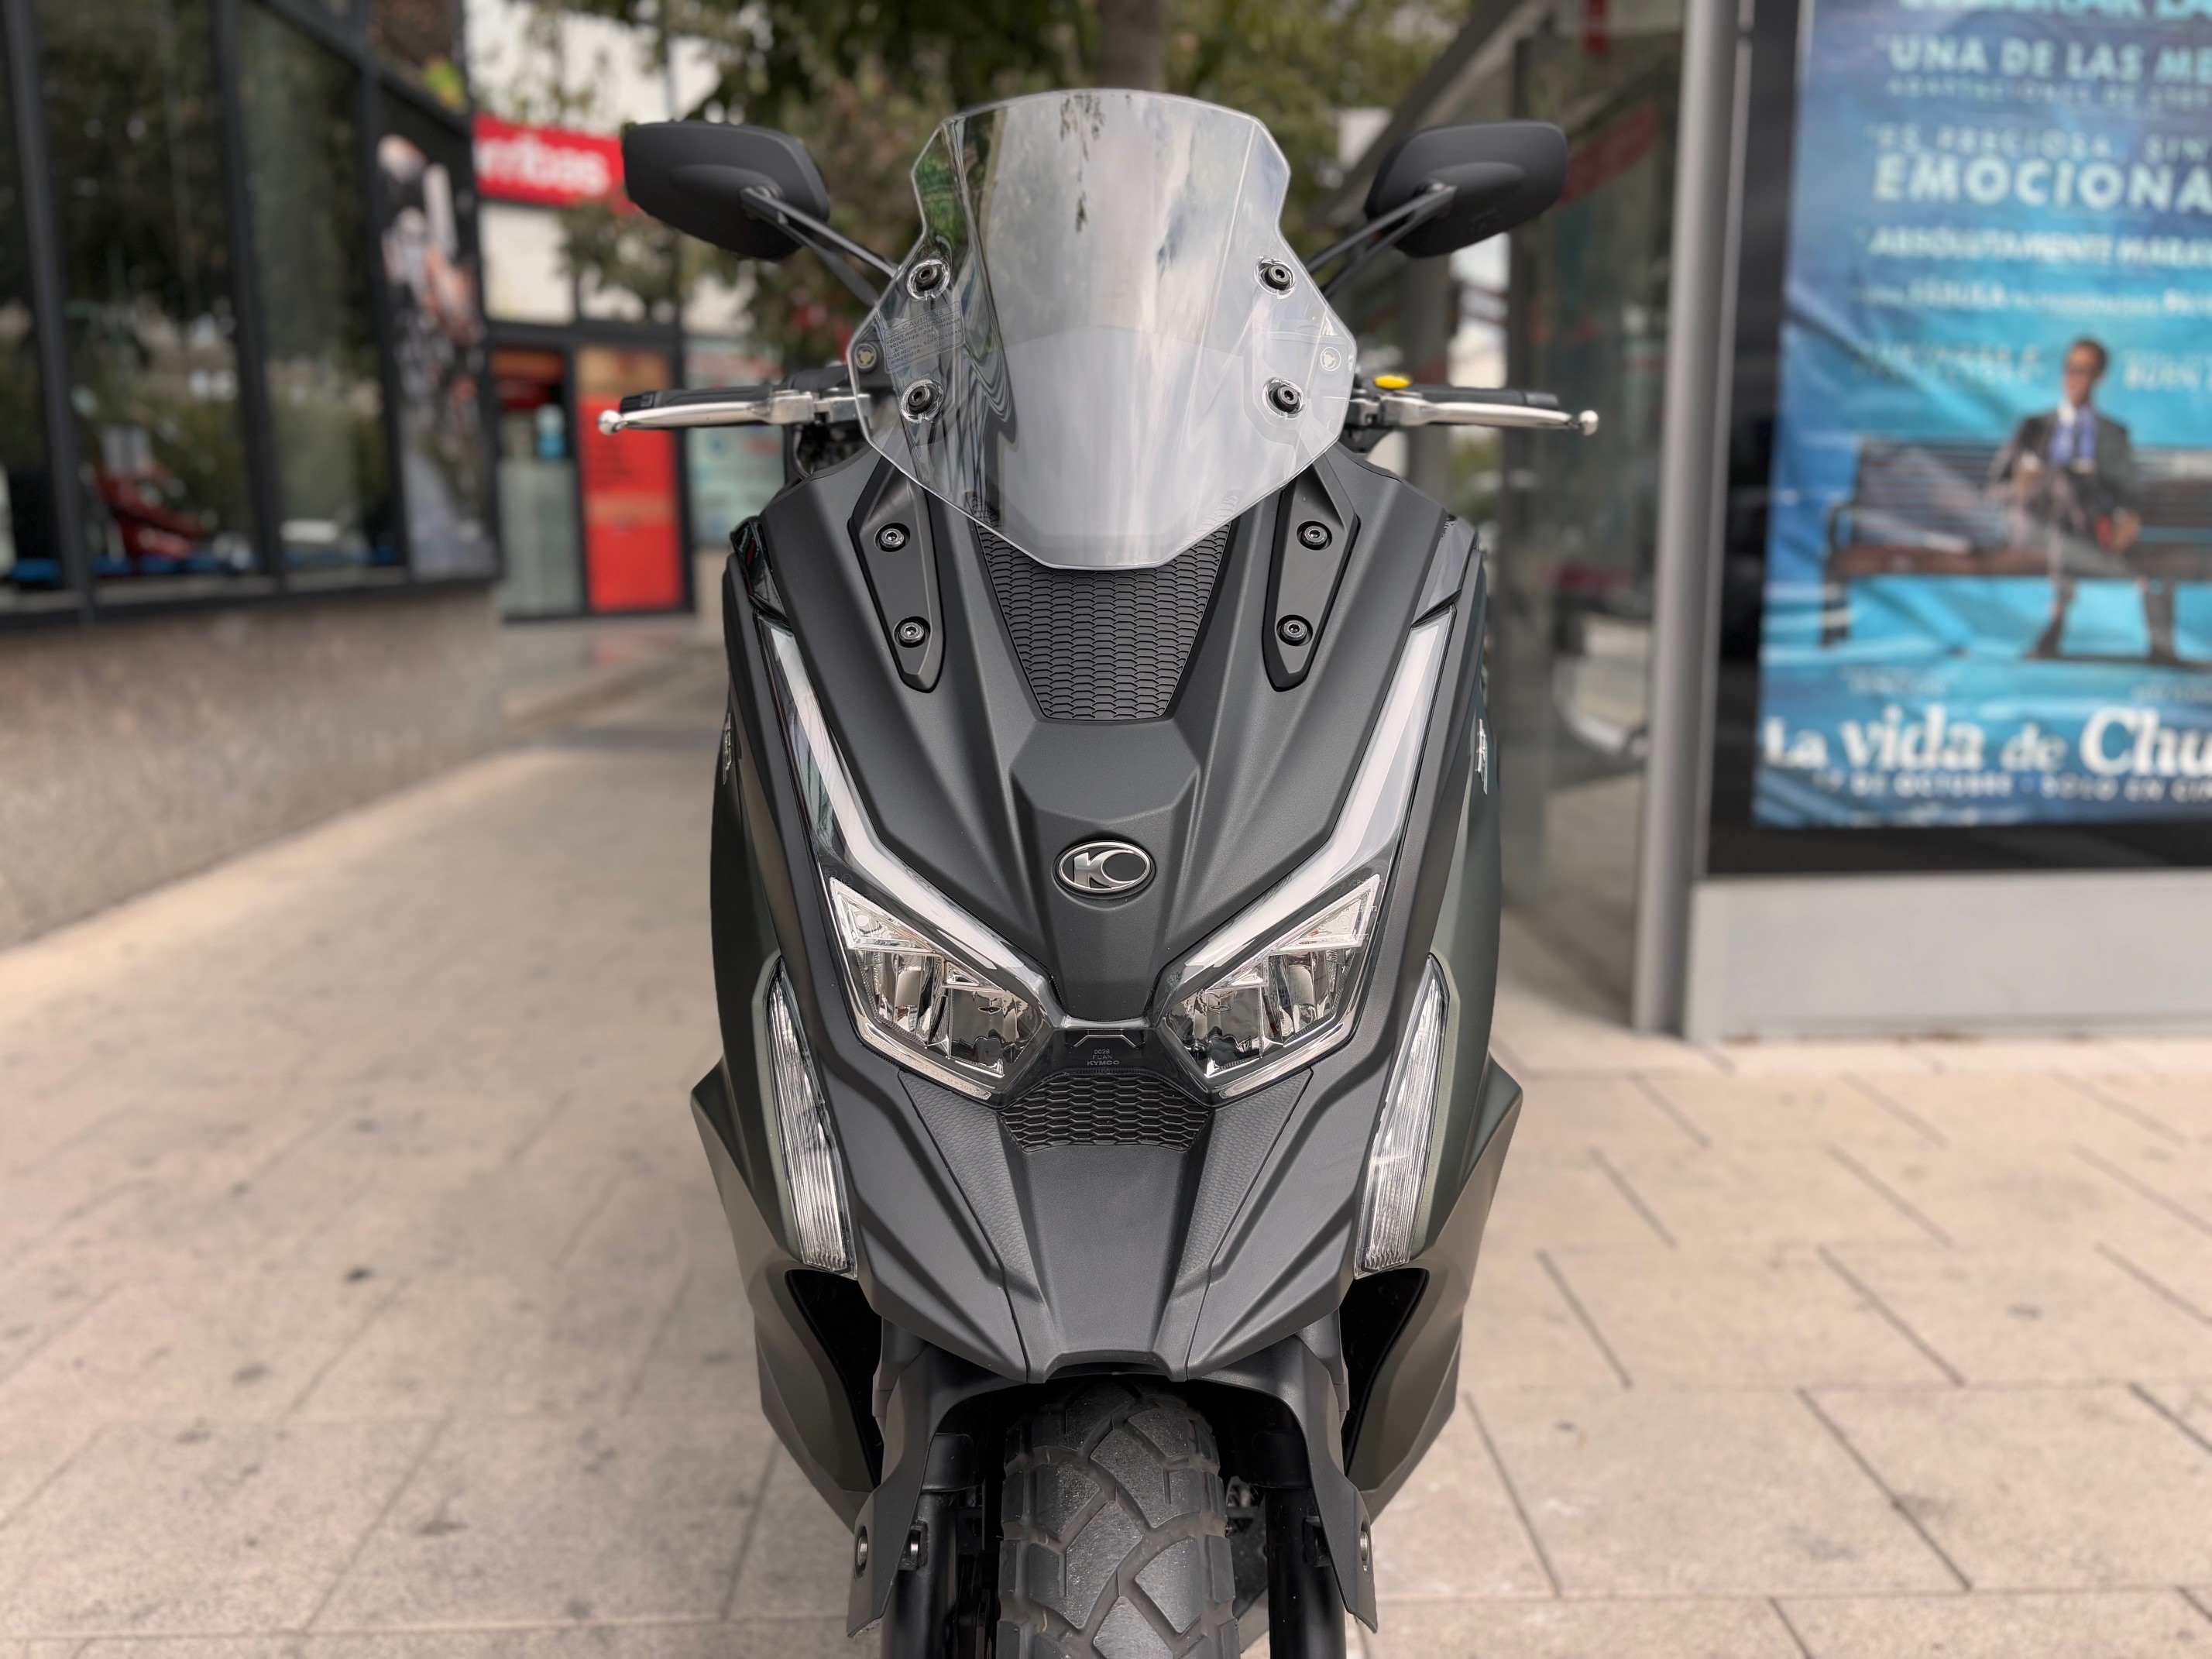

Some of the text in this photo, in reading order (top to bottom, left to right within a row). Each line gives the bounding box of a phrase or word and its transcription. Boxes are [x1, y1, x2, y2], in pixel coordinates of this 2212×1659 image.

[1889, 34, 1988, 74] UNA
[2000, 38, 2054, 77] DE
[2066, 42, 2144, 81] LAS
[1839, 705, 1987, 772] vida
[2000, 723, 2068, 772] de
